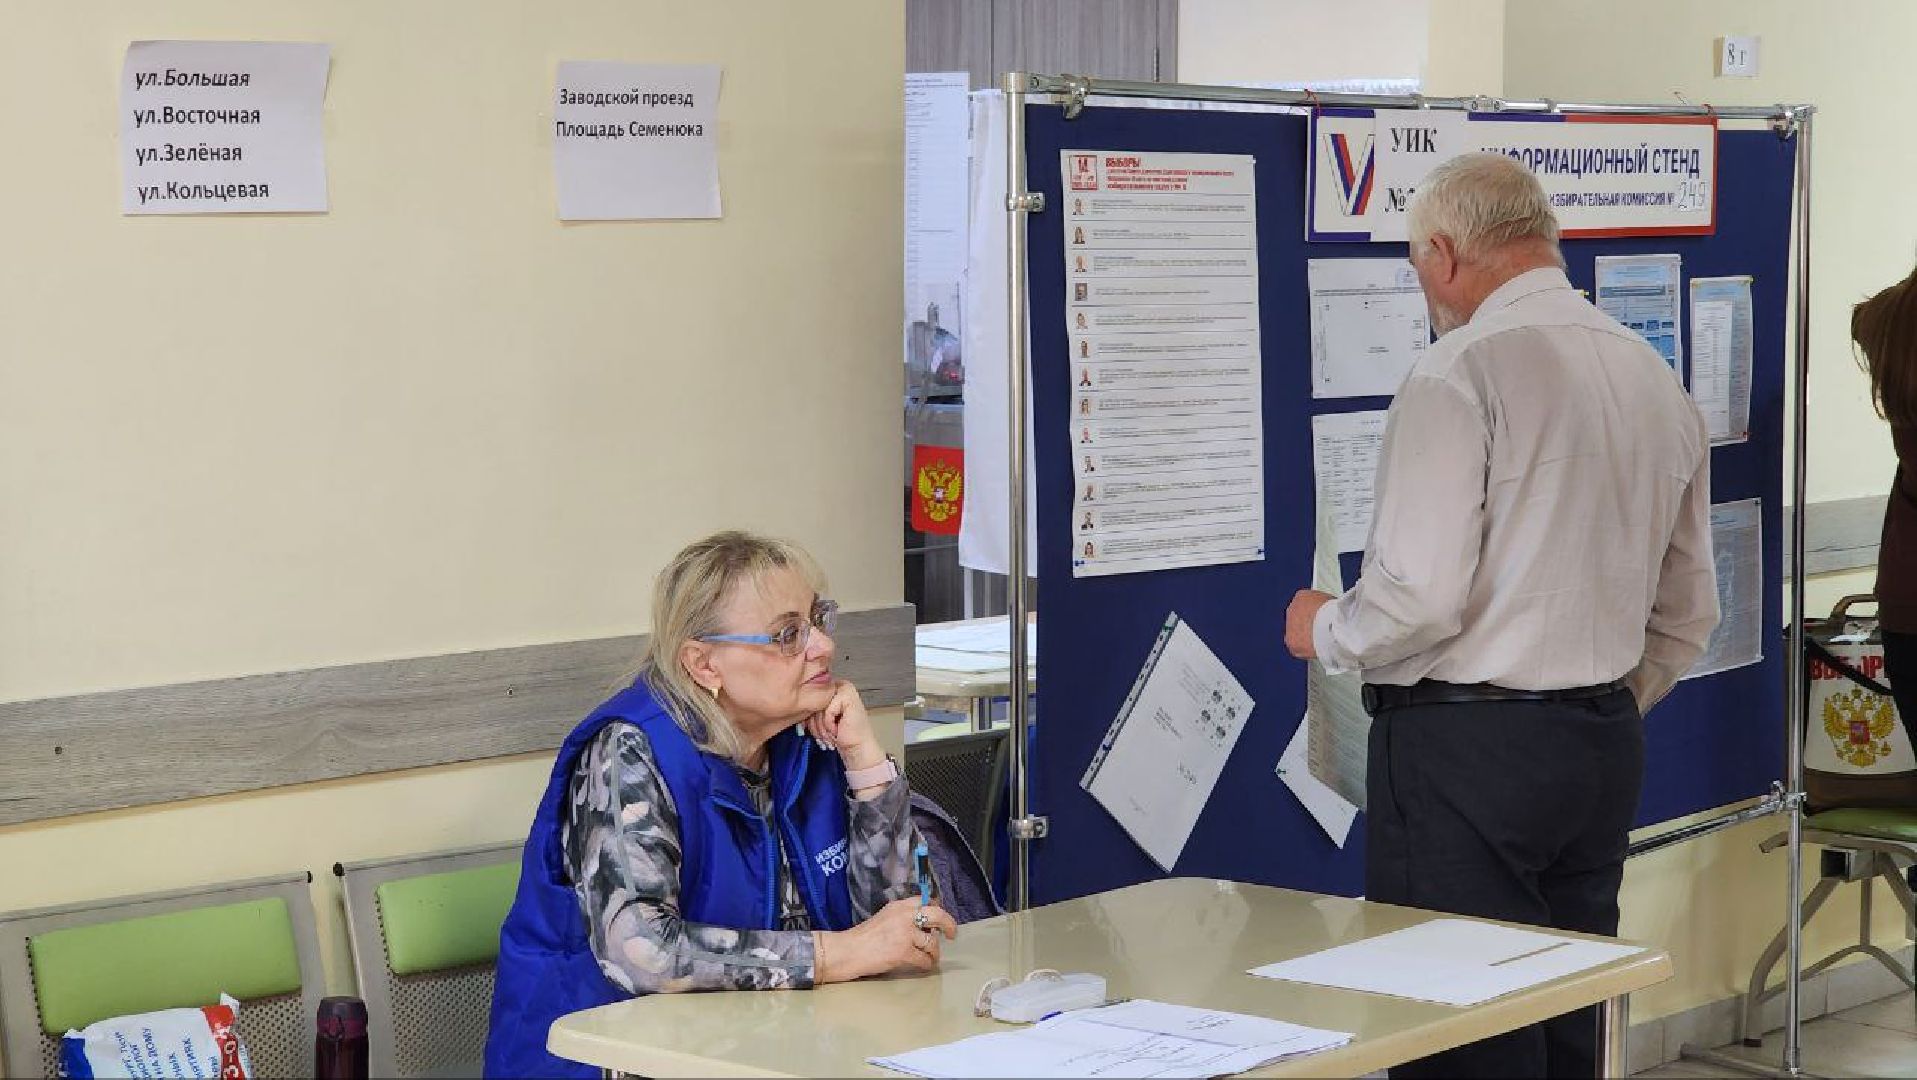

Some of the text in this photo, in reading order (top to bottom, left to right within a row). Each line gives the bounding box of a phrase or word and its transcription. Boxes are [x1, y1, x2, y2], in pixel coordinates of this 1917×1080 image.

[1727, 42, 1735, 66] 8
[135, 69, 251, 91] ул.Большая
[559, 88, 694, 108] Заводской проезд
[133, 106, 261, 128] ул.Восточная
[556, 121, 703, 140] Площадь Семенюка
[1390, 127, 1438, 153] УИК
[135, 142, 242, 167] ул.Зелёная
[1652, 148, 1700, 179] СТЕНД
[138, 181, 269, 205] ул.Кольцевая
[1622, 192, 1665, 206] КОМИССИЯ
